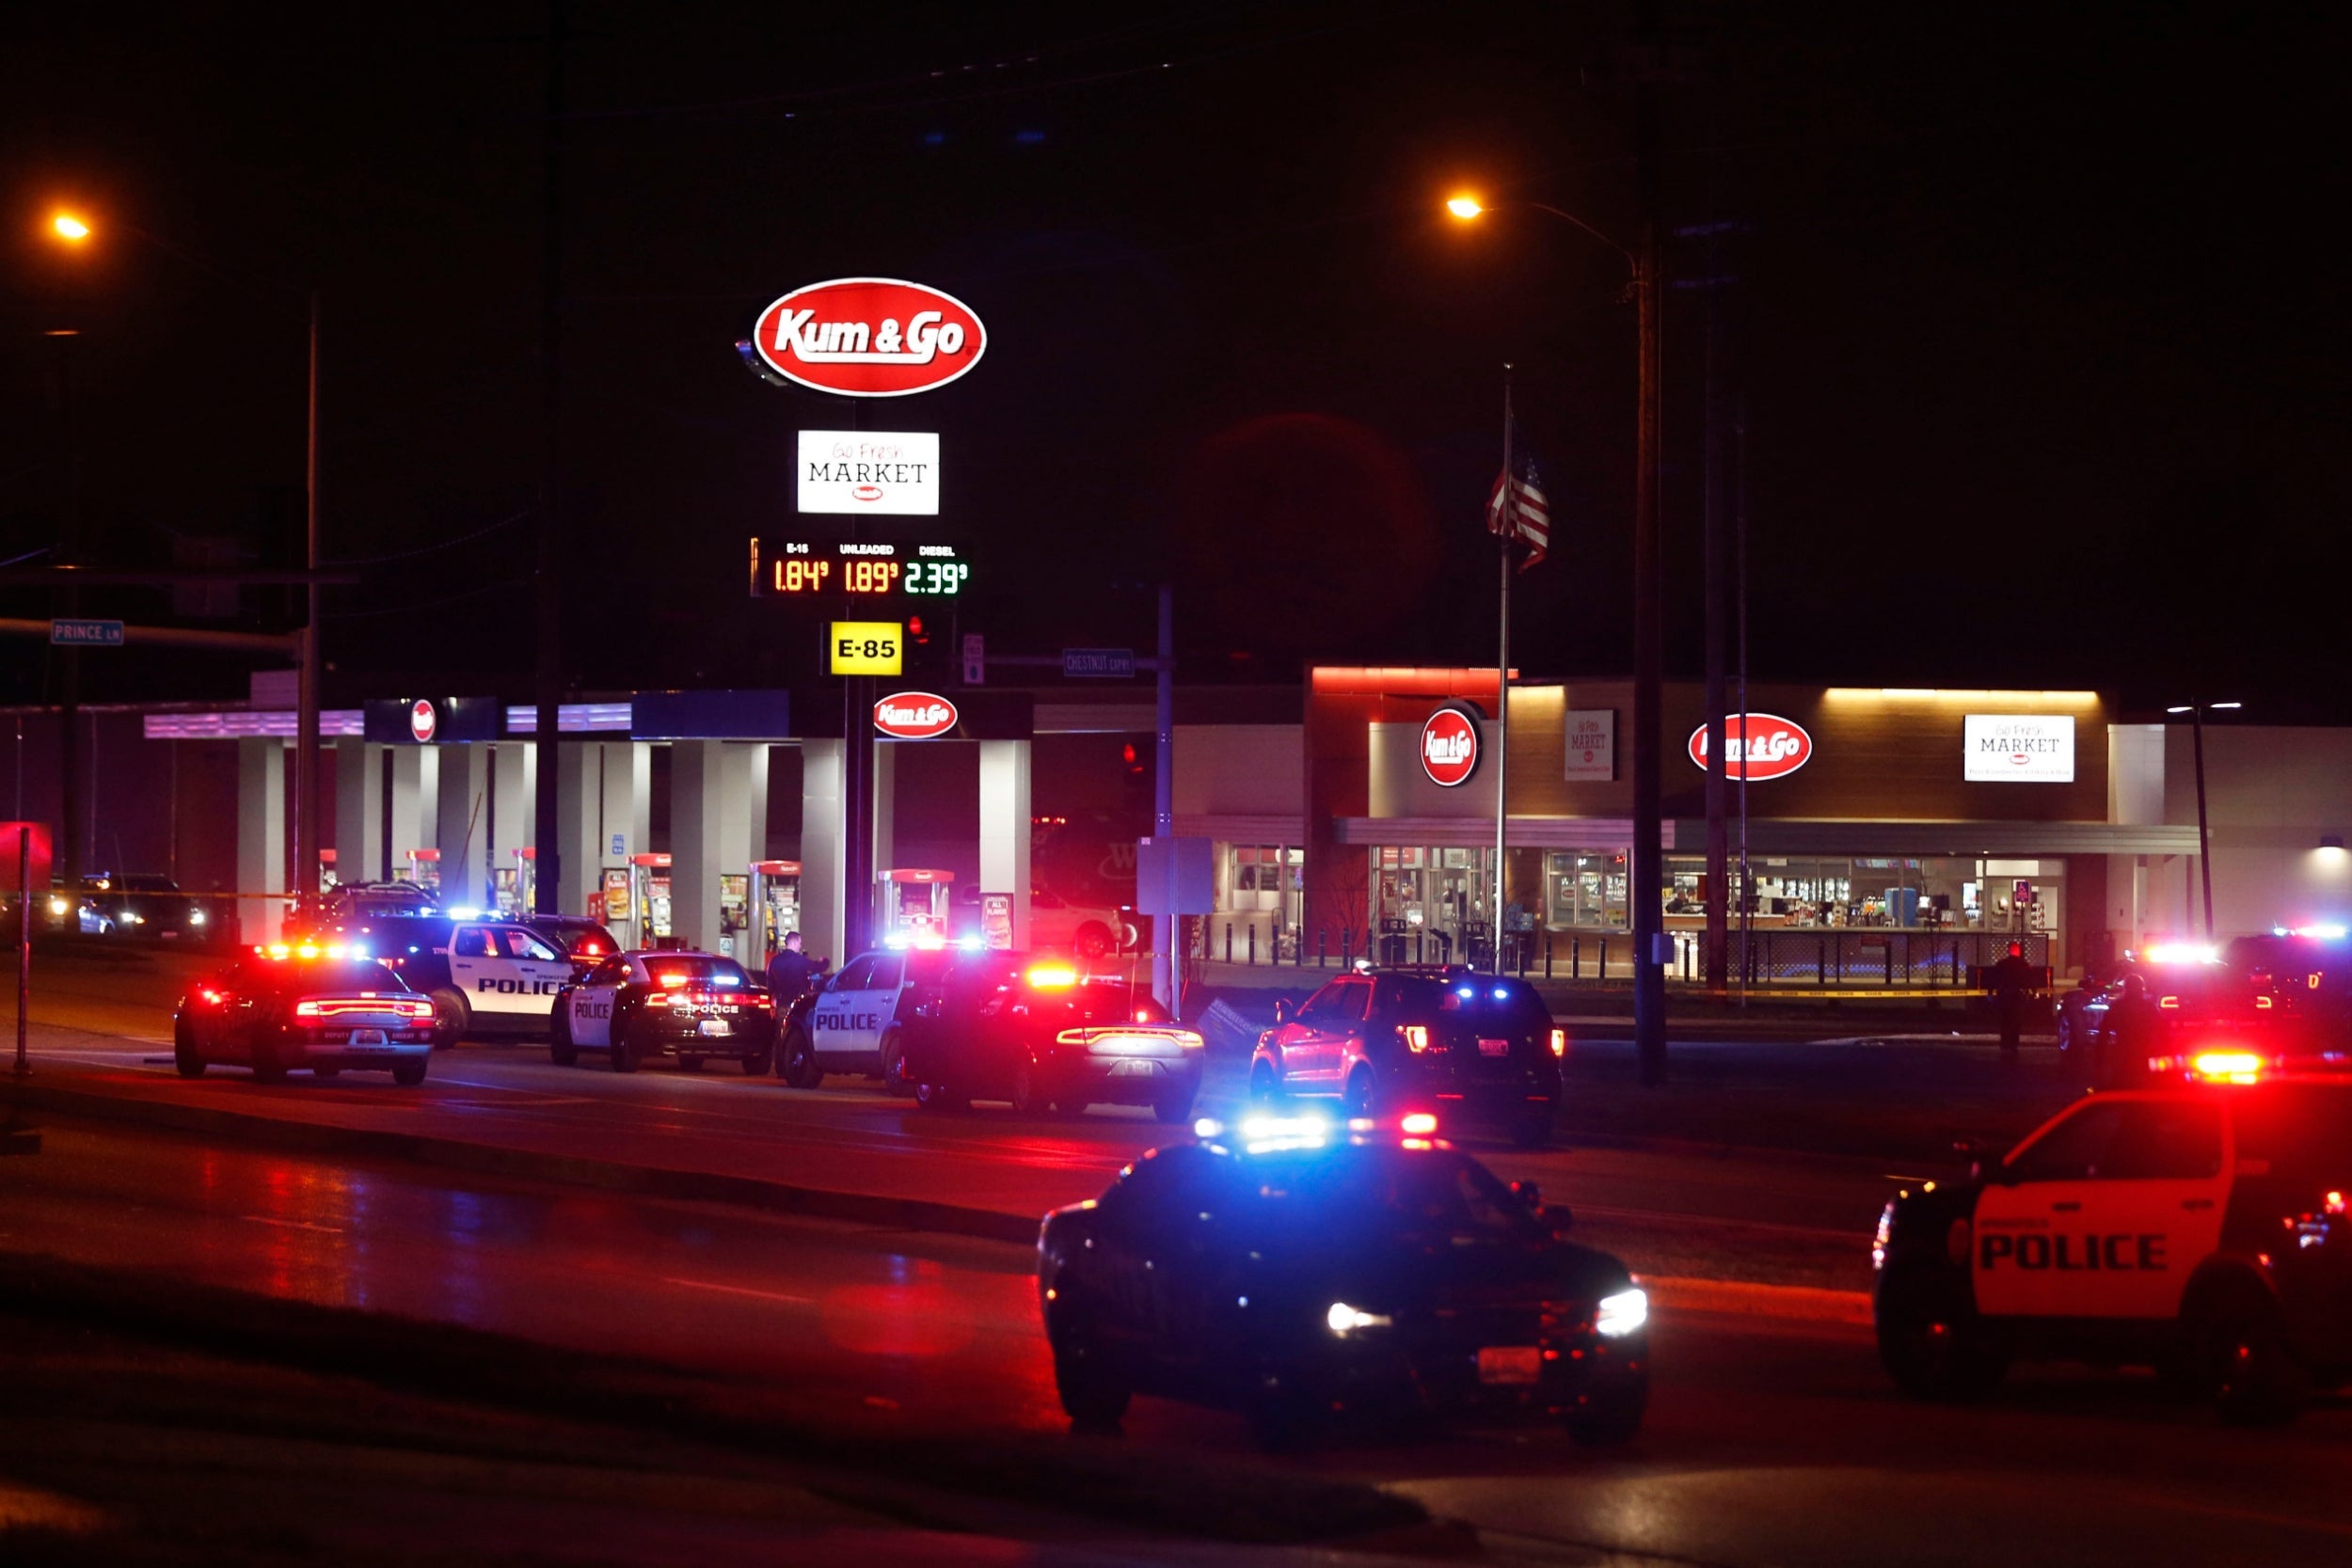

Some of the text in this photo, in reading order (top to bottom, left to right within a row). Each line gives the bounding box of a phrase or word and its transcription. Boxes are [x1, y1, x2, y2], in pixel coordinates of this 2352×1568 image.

[774, 309, 964, 363] Kum & Go
[809, 463, 927, 483] MARKET
[787, 543, 809, 554] E-15
[839, 544, 895, 555] UNLEADED
[918, 546, 955, 557] DIESEL
[56, 625, 120, 639] PRINCE LN
[838, 639, 896, 658] E-85
[1067, 655, 1106, 670] CHESTNUT
[879, 704, 949, 725] Kum & Go
[1425, 730, 1449, 763] Kum
[1456, 730, 1470, 763] Go
[1571, 734, 1606, 750] MARKET
[1753, 736, 1768, 756] &
[1769, 731, 1800, 761] Go
[1980, 738, 2059, 752] MARKET
[575, 1003, 609, 1020] POLICE
[692, 1005, 739, 1014] POLICE
[817, 1014, 877, 1030] POLICE
[1981, 1235, 2167, 1270] POLICE
